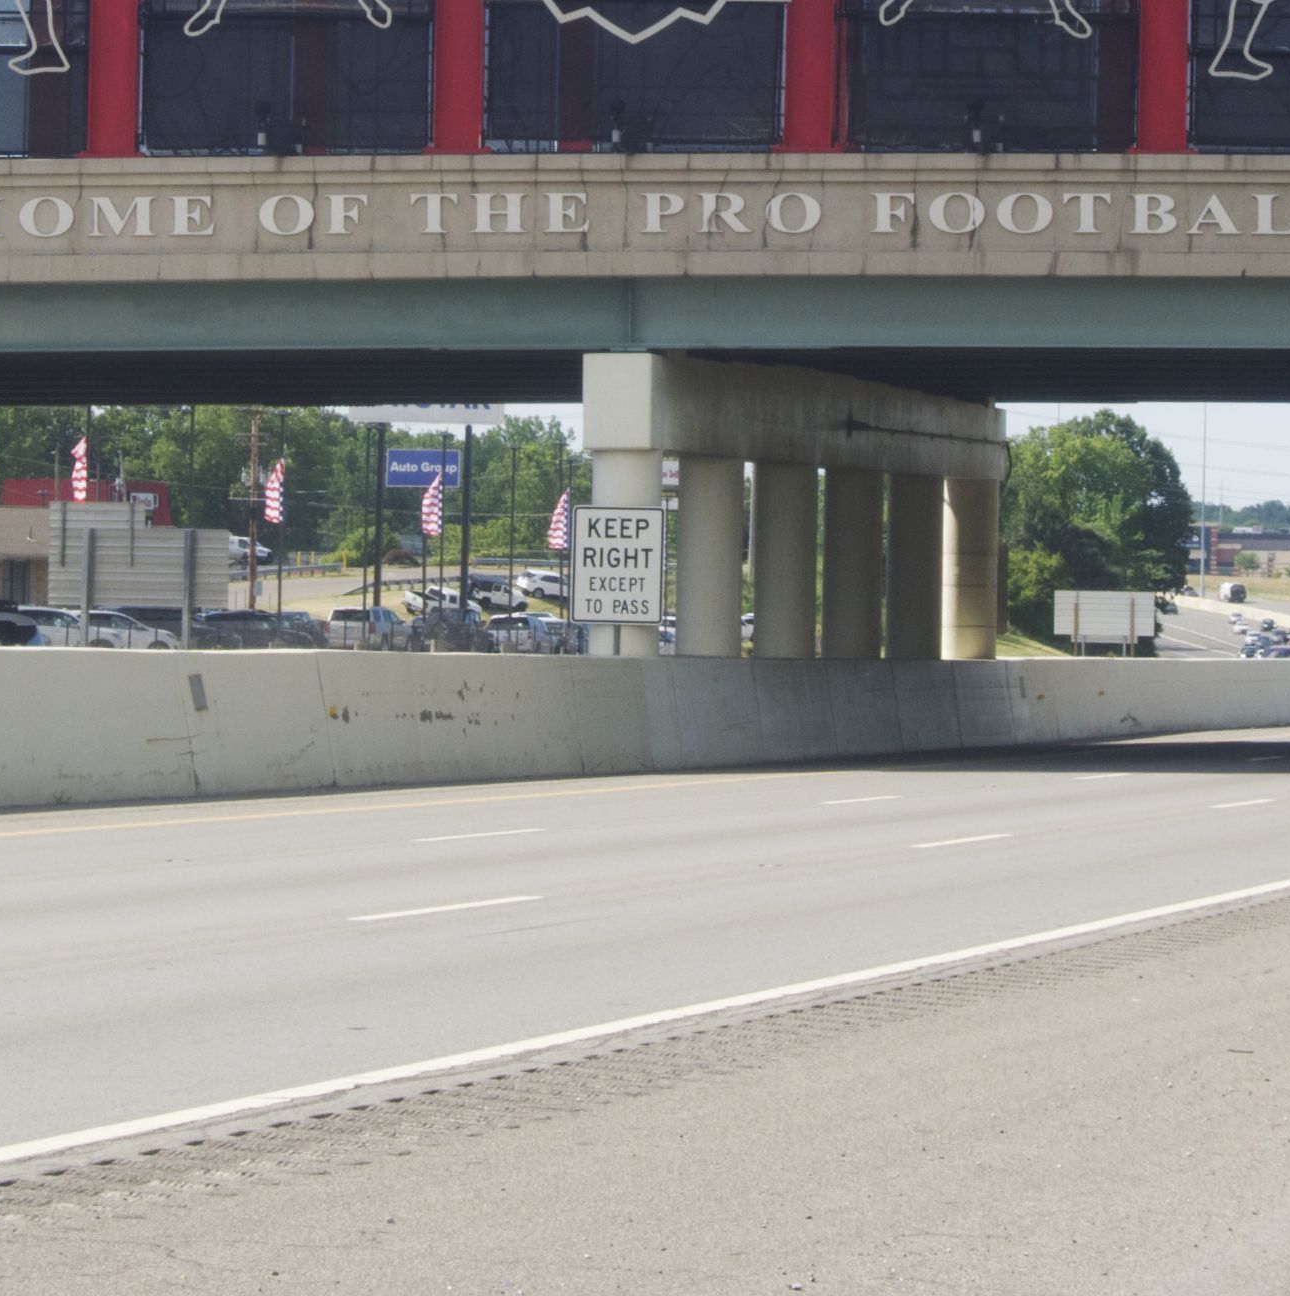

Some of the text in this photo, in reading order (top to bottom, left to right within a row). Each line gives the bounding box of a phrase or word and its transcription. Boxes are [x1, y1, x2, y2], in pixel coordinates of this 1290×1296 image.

[258, 193, 369, 236] OF
[410, 192, 591, 234] THE
[640, 192, 822, 234] PRO
[390, 461, 418, 472] Auto
[587, 518, 650, 539] KEEP
[583, 547, 653, 569] RIGHT
[589, 576, 646, 593] EXCEPT
[585, 598, 650, 615] TO PASS
